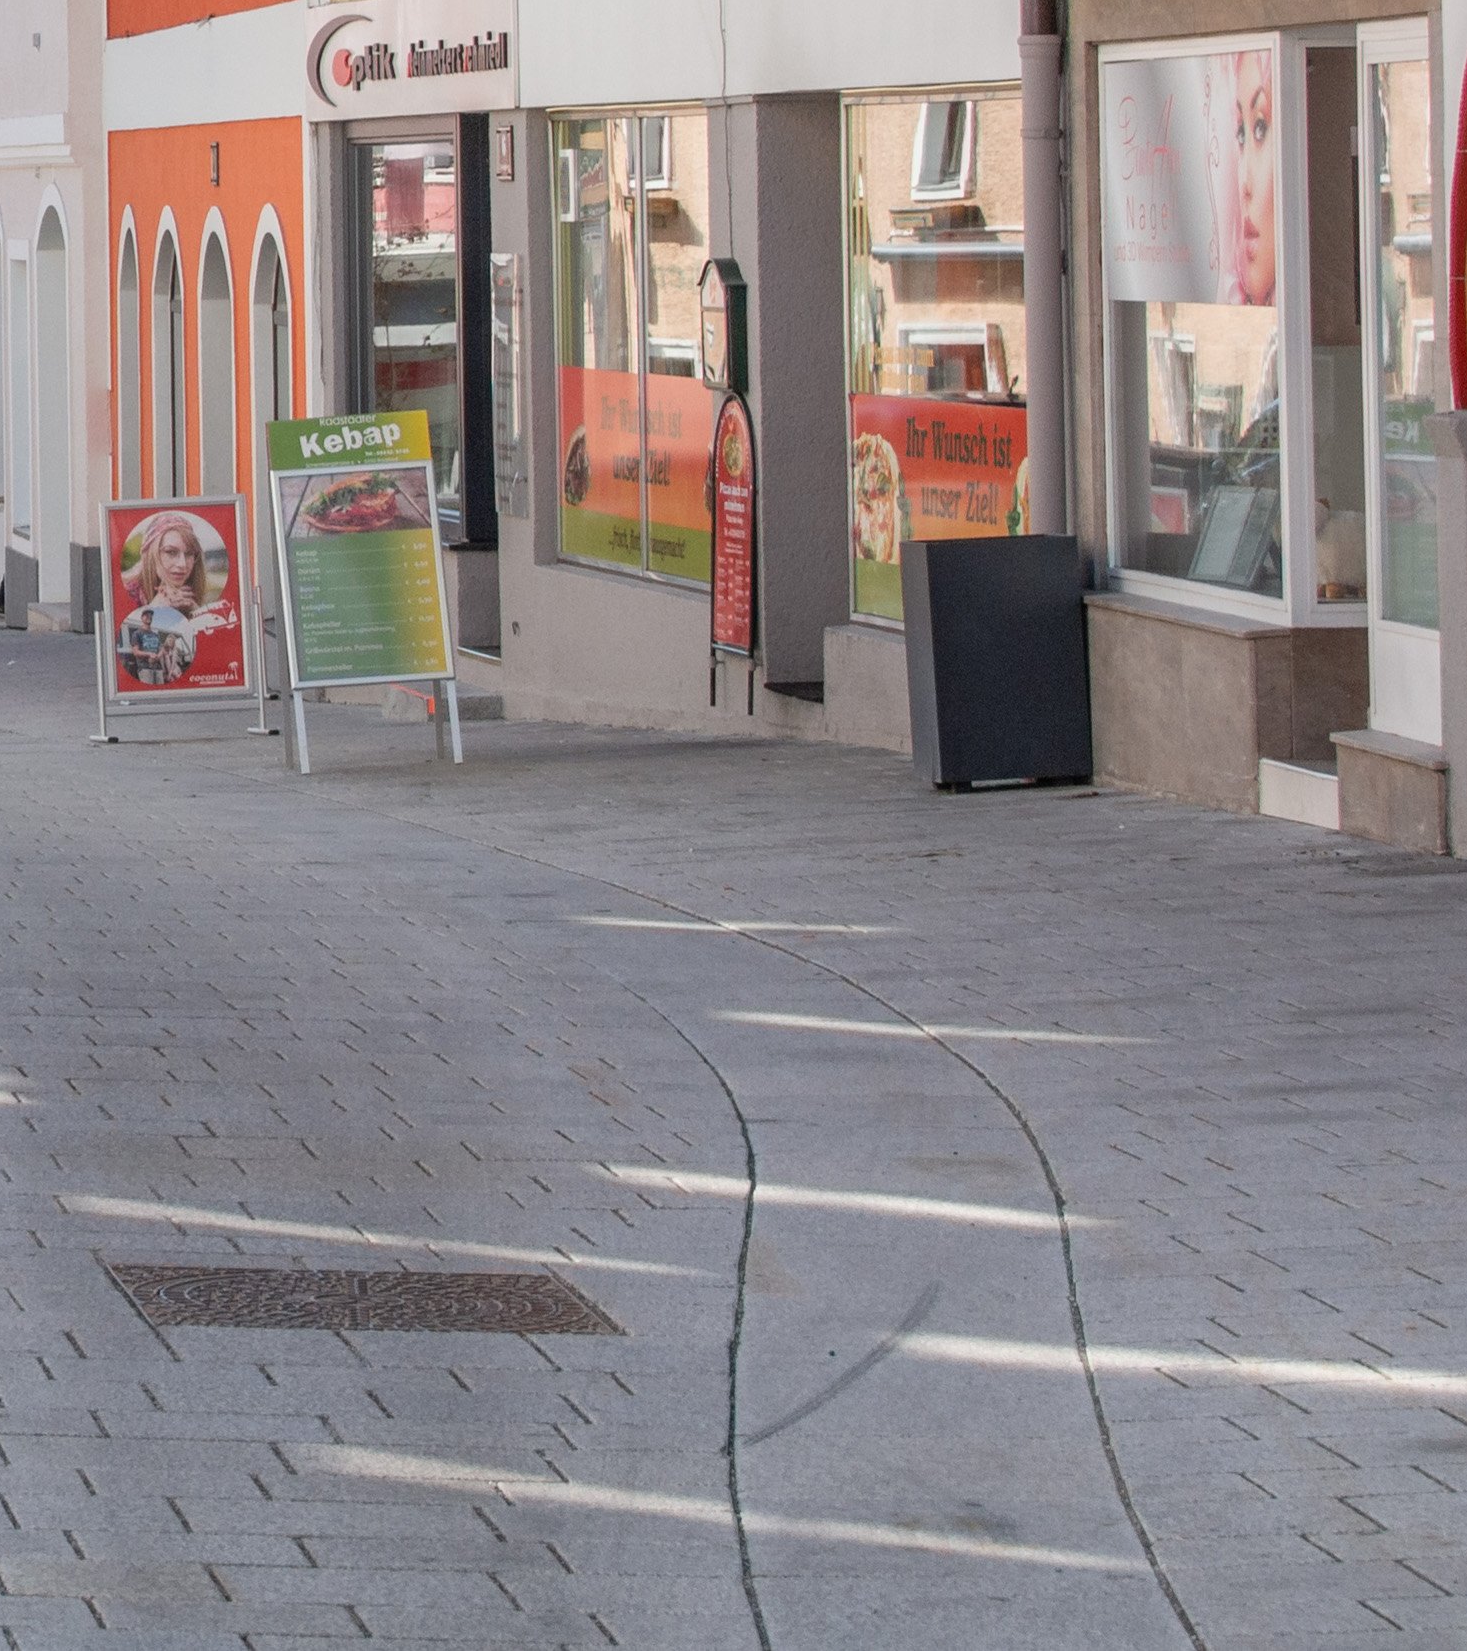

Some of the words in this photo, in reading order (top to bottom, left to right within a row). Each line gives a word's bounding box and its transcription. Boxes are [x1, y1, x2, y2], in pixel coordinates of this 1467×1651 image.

[299, 423, 401, 459] Kebap
[906, 416, 928, 458] Ihr
[931, 420, 989, 466] Wunsch
[992, 423, 1013, 469] ist
[921, 486, 962, 520] unser
[965, 481, 1000, 526] Ziel!
[188, 671, 235, 683] coconuts
